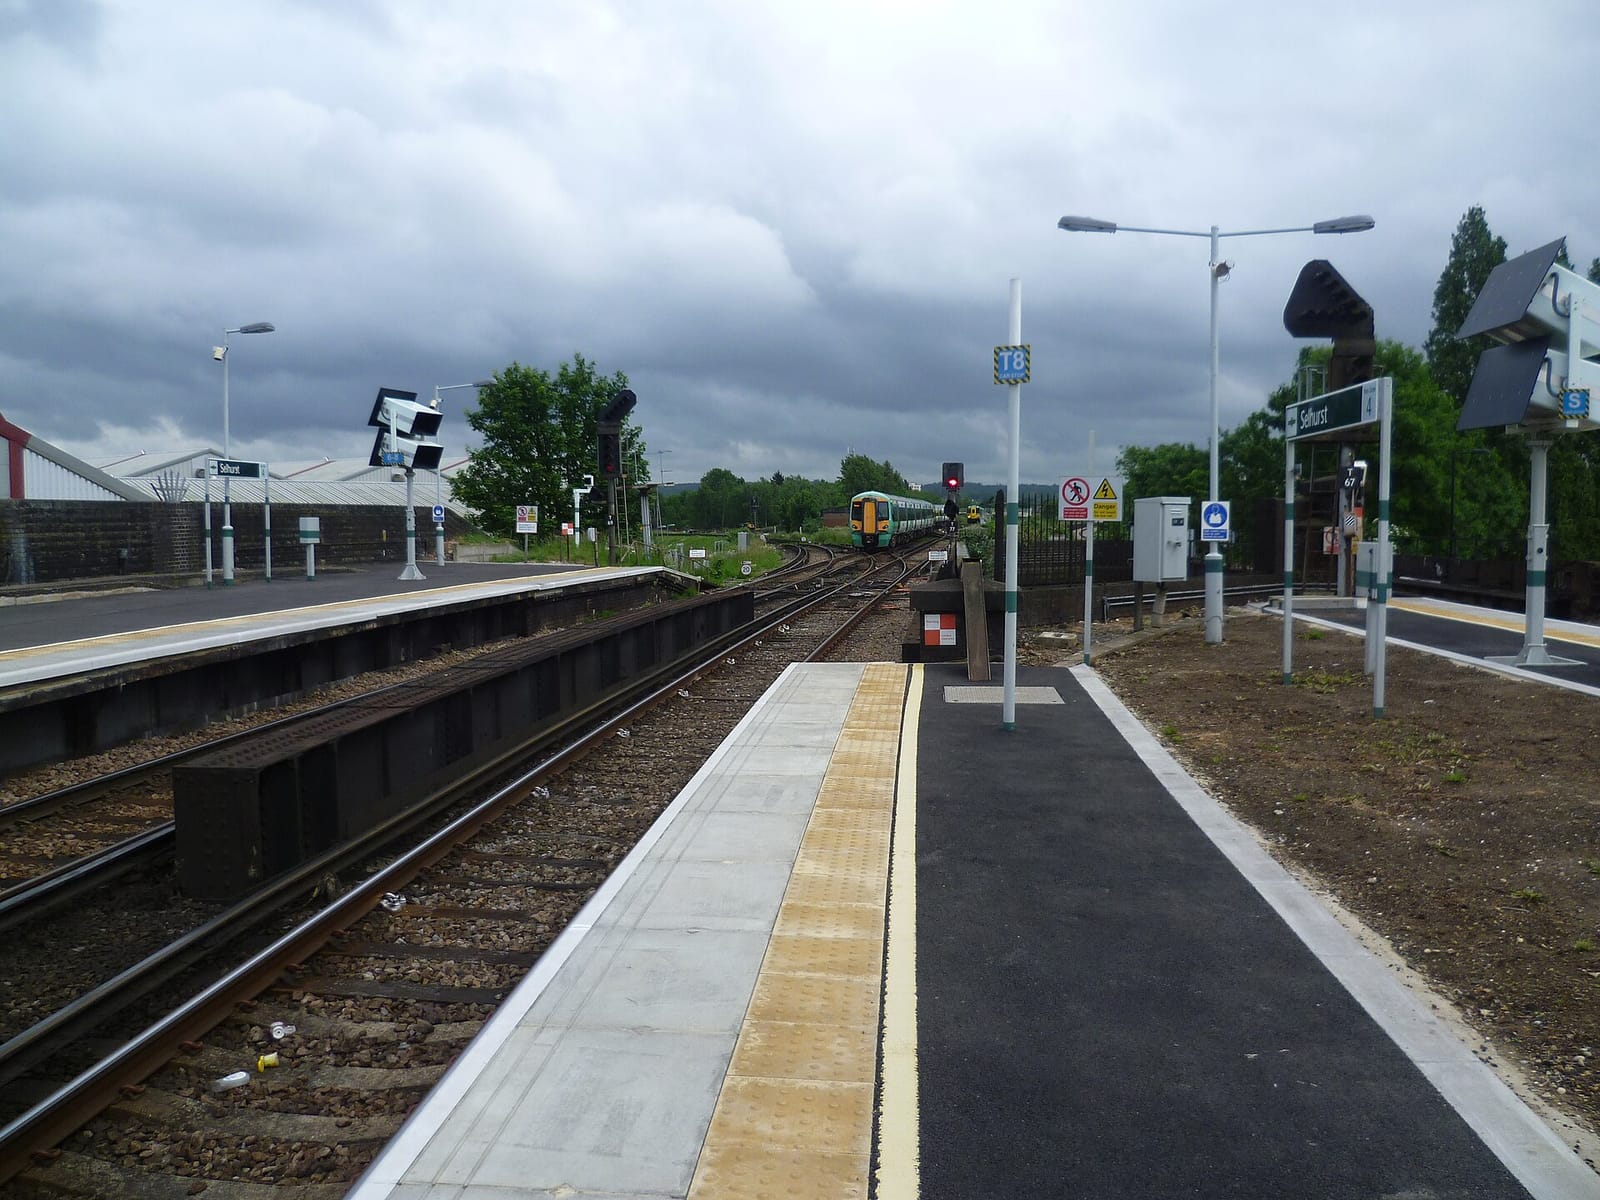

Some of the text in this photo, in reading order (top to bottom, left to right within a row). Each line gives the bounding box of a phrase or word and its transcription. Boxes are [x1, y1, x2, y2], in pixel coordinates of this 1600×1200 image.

[1000, 351, 1024, 370] T8
[1366, 397, 1372, 416] 4
[1568, 393, 1581, 408] S
[1300, 405, 1328, 430] Selhurst
[1347, 468, 1353, 477] T
[1344, 478, 1355, 487] 67
[742, 565, 751, 573] 20
